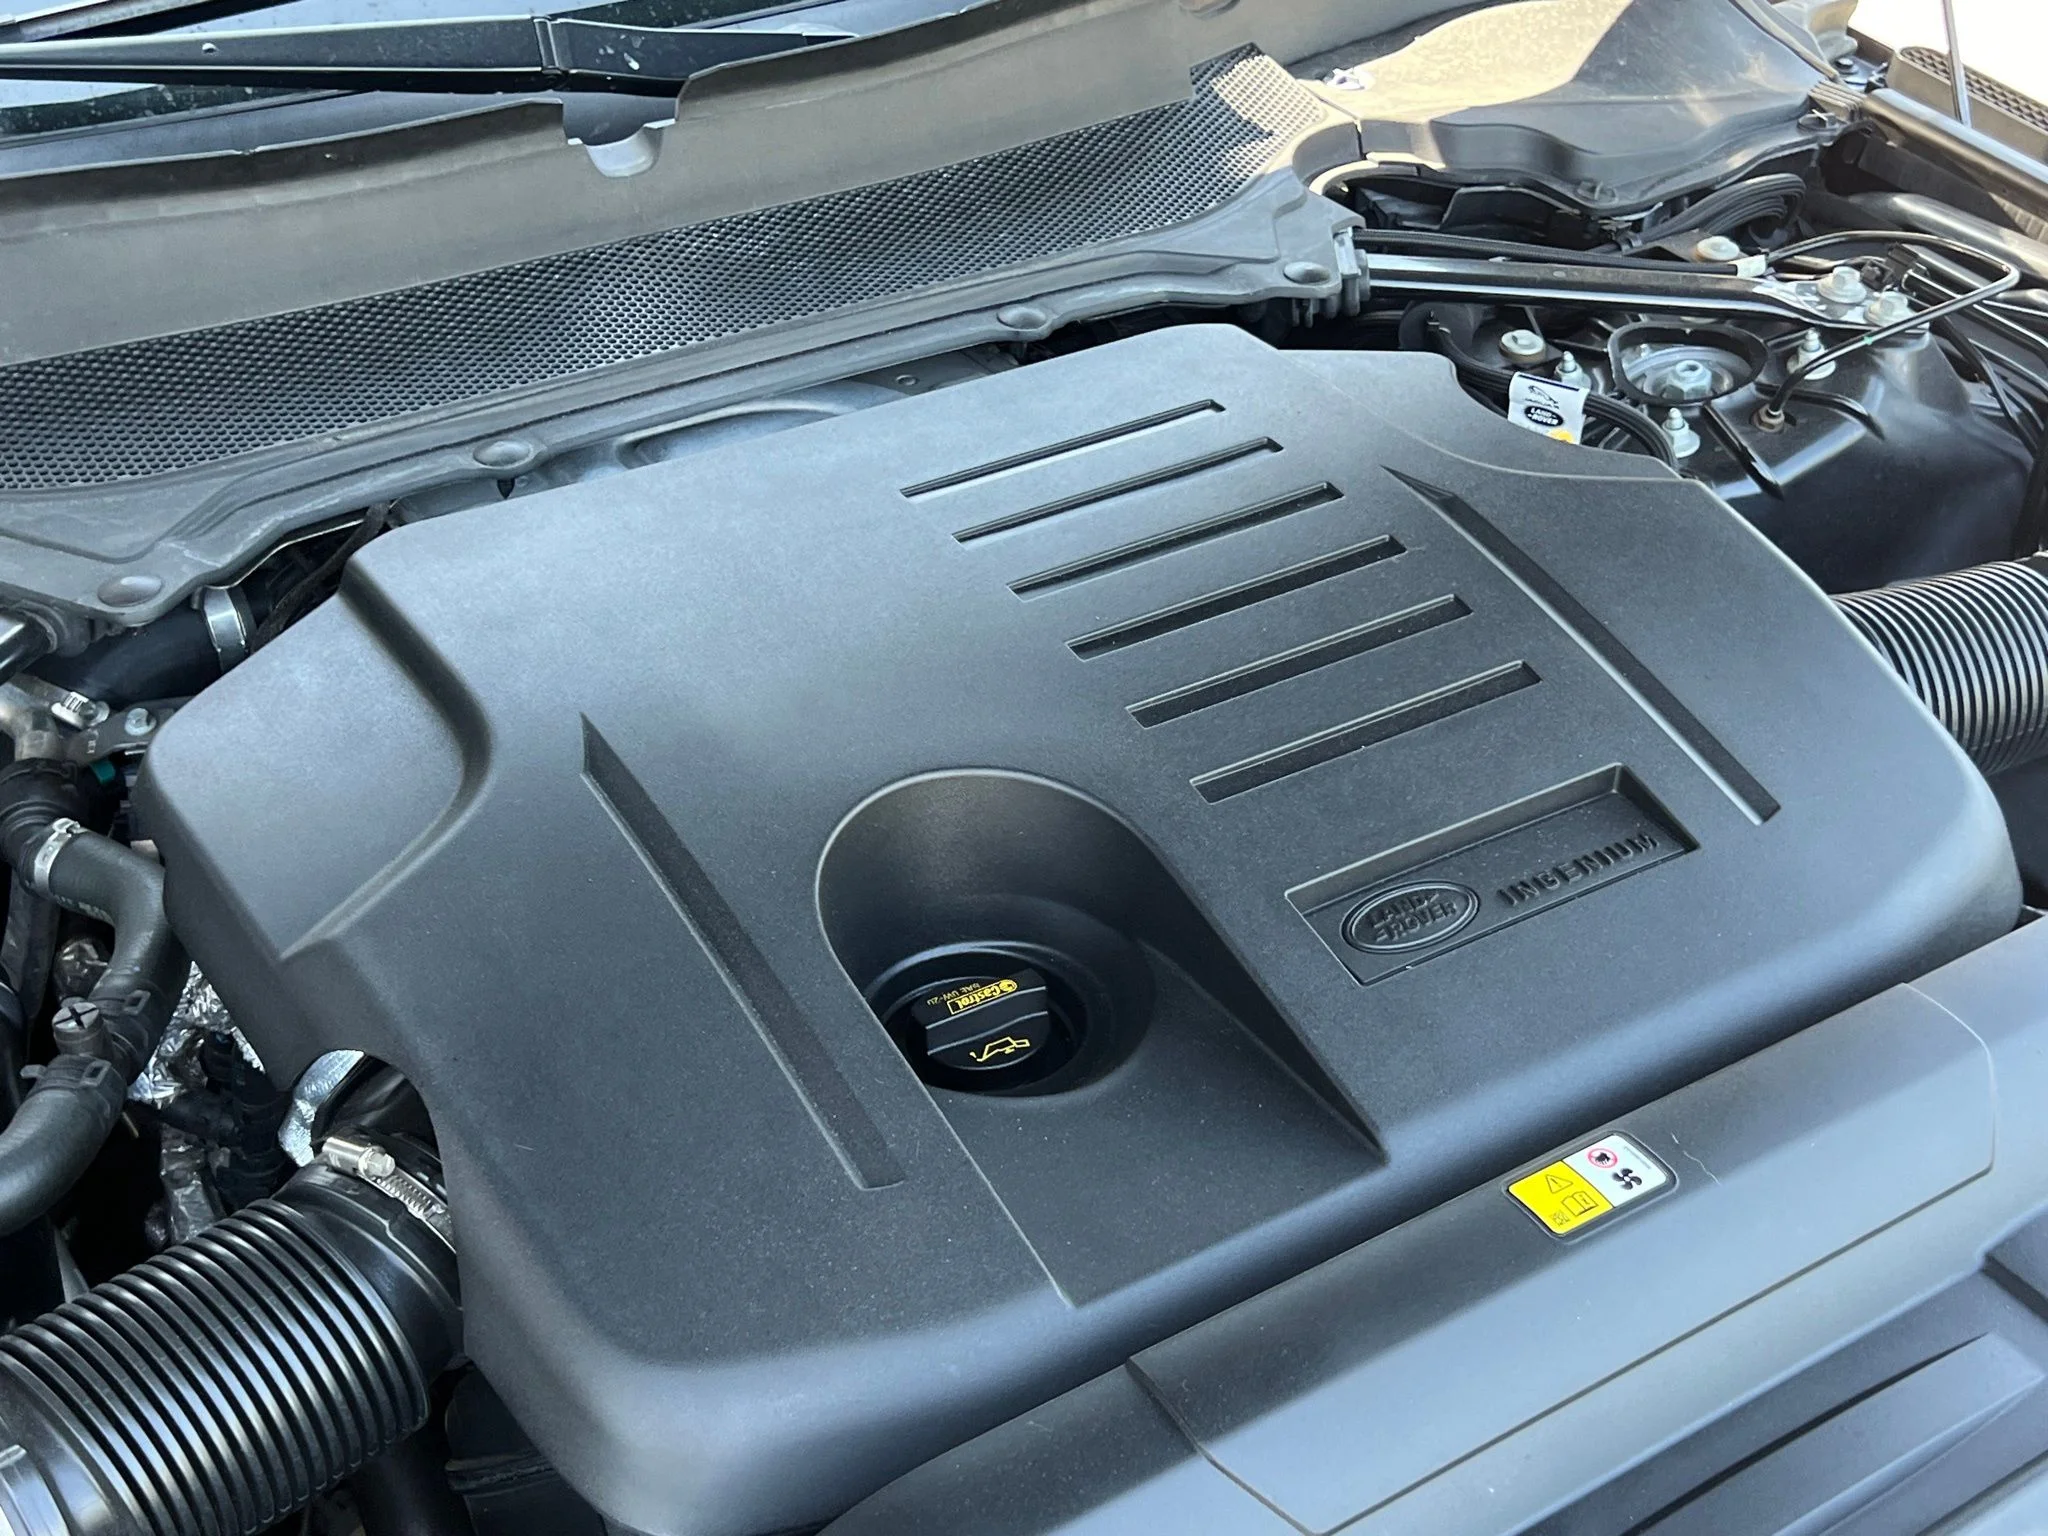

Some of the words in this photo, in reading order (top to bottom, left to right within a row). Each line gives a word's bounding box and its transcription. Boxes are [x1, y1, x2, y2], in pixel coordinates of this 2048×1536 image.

[1496, 833, 1660, 907] INGENIUM
[1365, 894, 1430, 928] LAND
[1383, 901, 1458, 942] ROVER
[955, 986, 1001, 1010] Castrol
